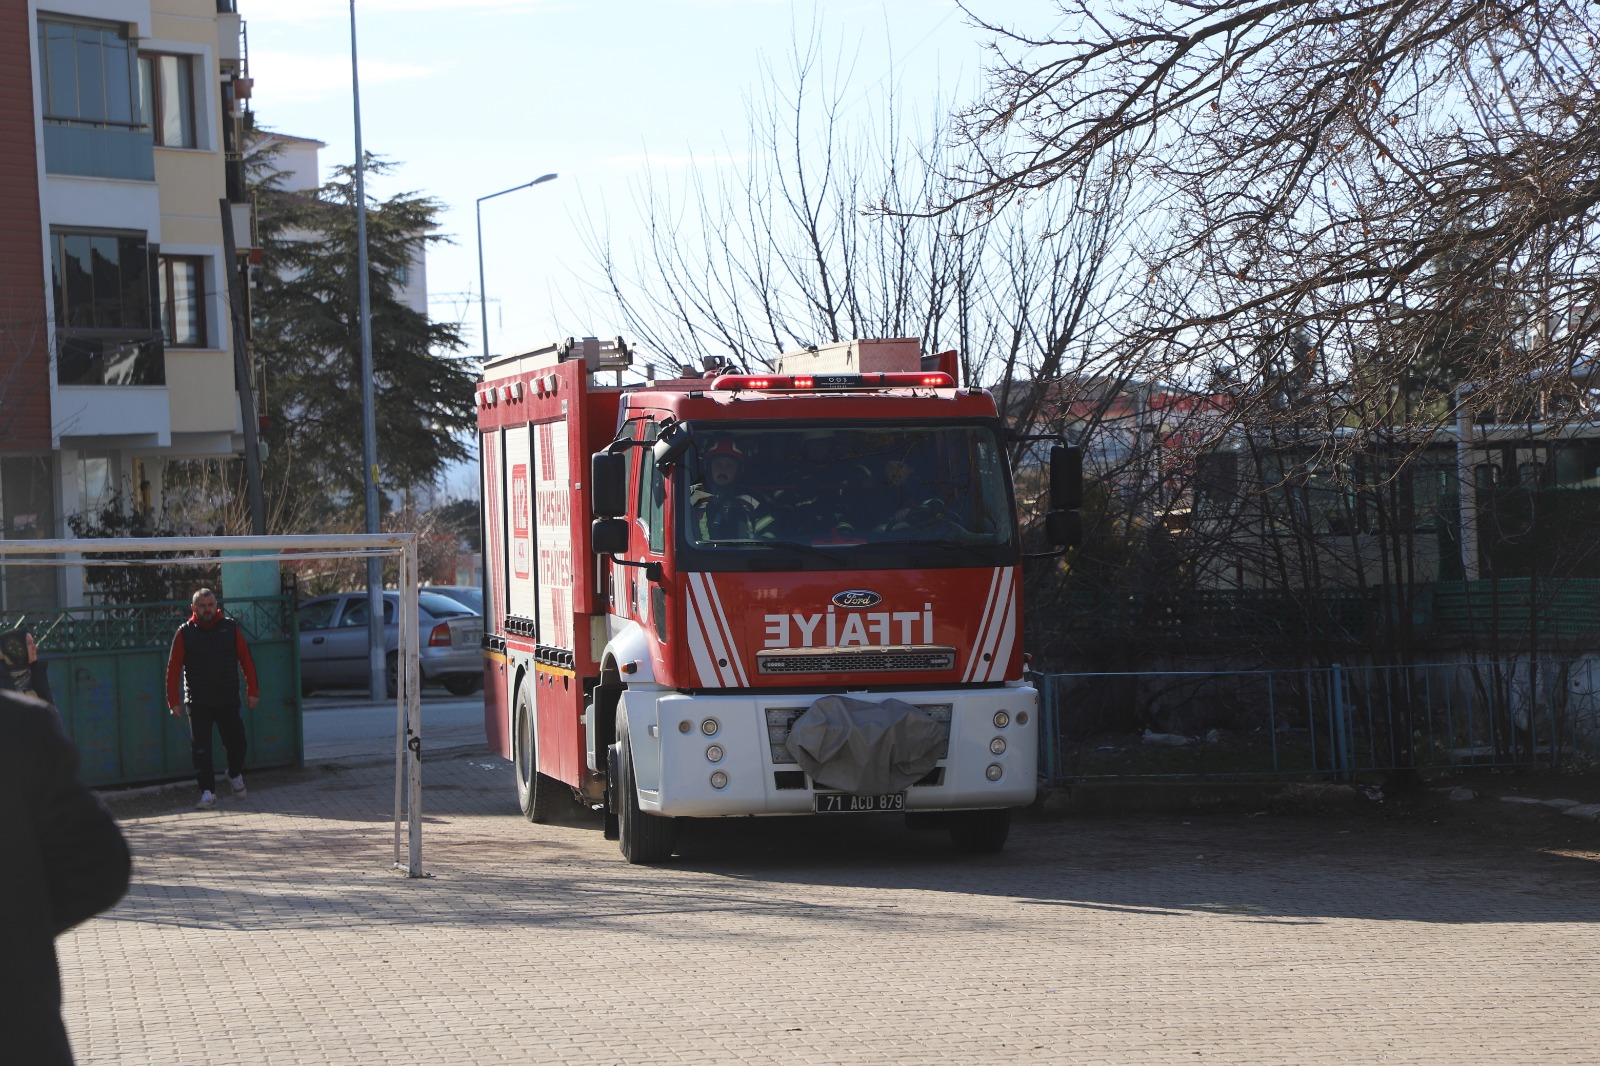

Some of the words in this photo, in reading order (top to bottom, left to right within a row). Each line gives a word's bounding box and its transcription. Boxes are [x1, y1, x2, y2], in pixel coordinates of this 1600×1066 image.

[514, 477, 528, 529] 112
[844, 592, 871, 605] Ford
[826, 796, 842, 810] 71
[850, 795, 874, 810] ACD
[879, 794, 903, 809] 879
